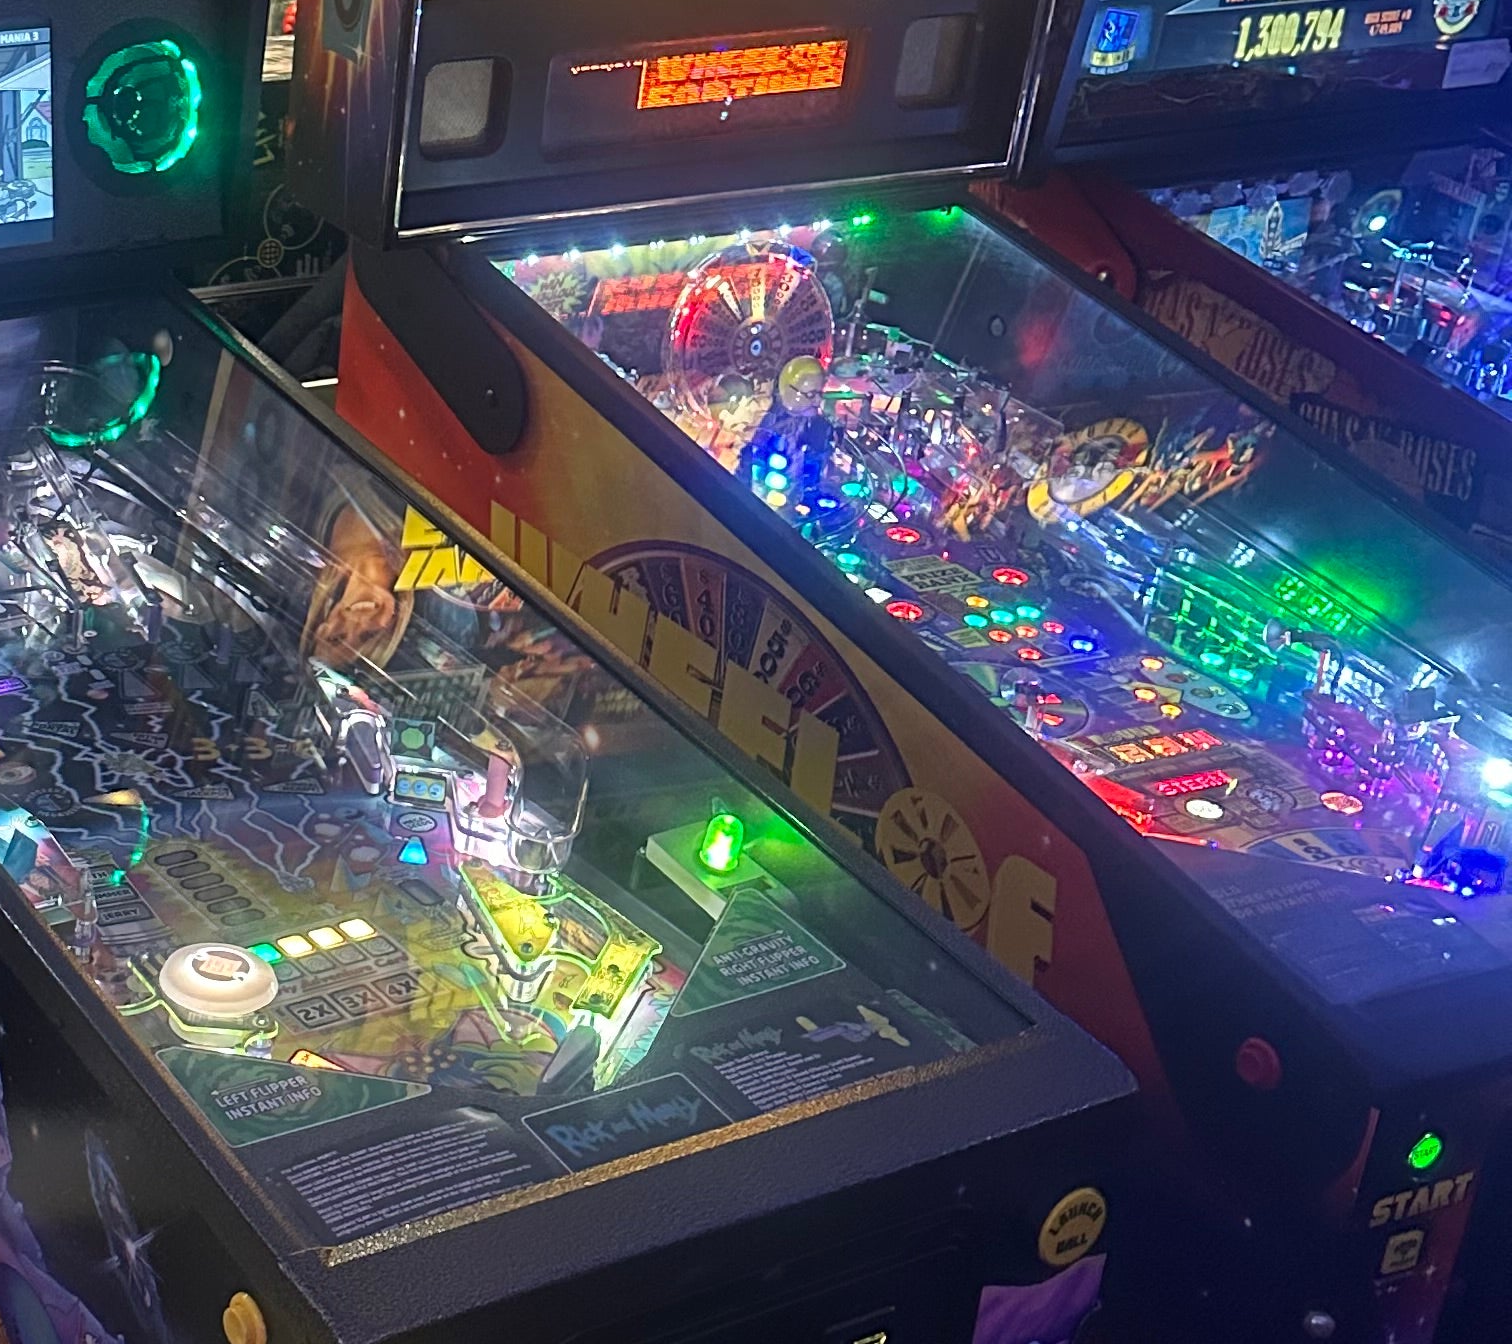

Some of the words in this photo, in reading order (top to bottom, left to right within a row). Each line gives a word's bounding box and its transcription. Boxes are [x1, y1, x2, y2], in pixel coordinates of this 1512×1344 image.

[1234, 7, 1346, 62] 1,300,794
[712, 935, 794, 966] ANTI-GRAVITY
[719, 959, 757, 976] RIGHT
[757, 946, 807, 967] FLIPPER
[737, 965, 789, 987] INSTANT
[789, 955, 820, 973] INFO
[297, 1004, 331, 1021] 2X
[215, 1088, 249, 1109] LEFT
[250, 1074, 309, 1099] FLIPPER
[224, 1095, 288, 1122] INSTANT
[287, 1086, 322, 1105] INFO
[1368, 1171, 1475, 1229] START
[1048, 1201, 1104, 1236] LAUNCH
